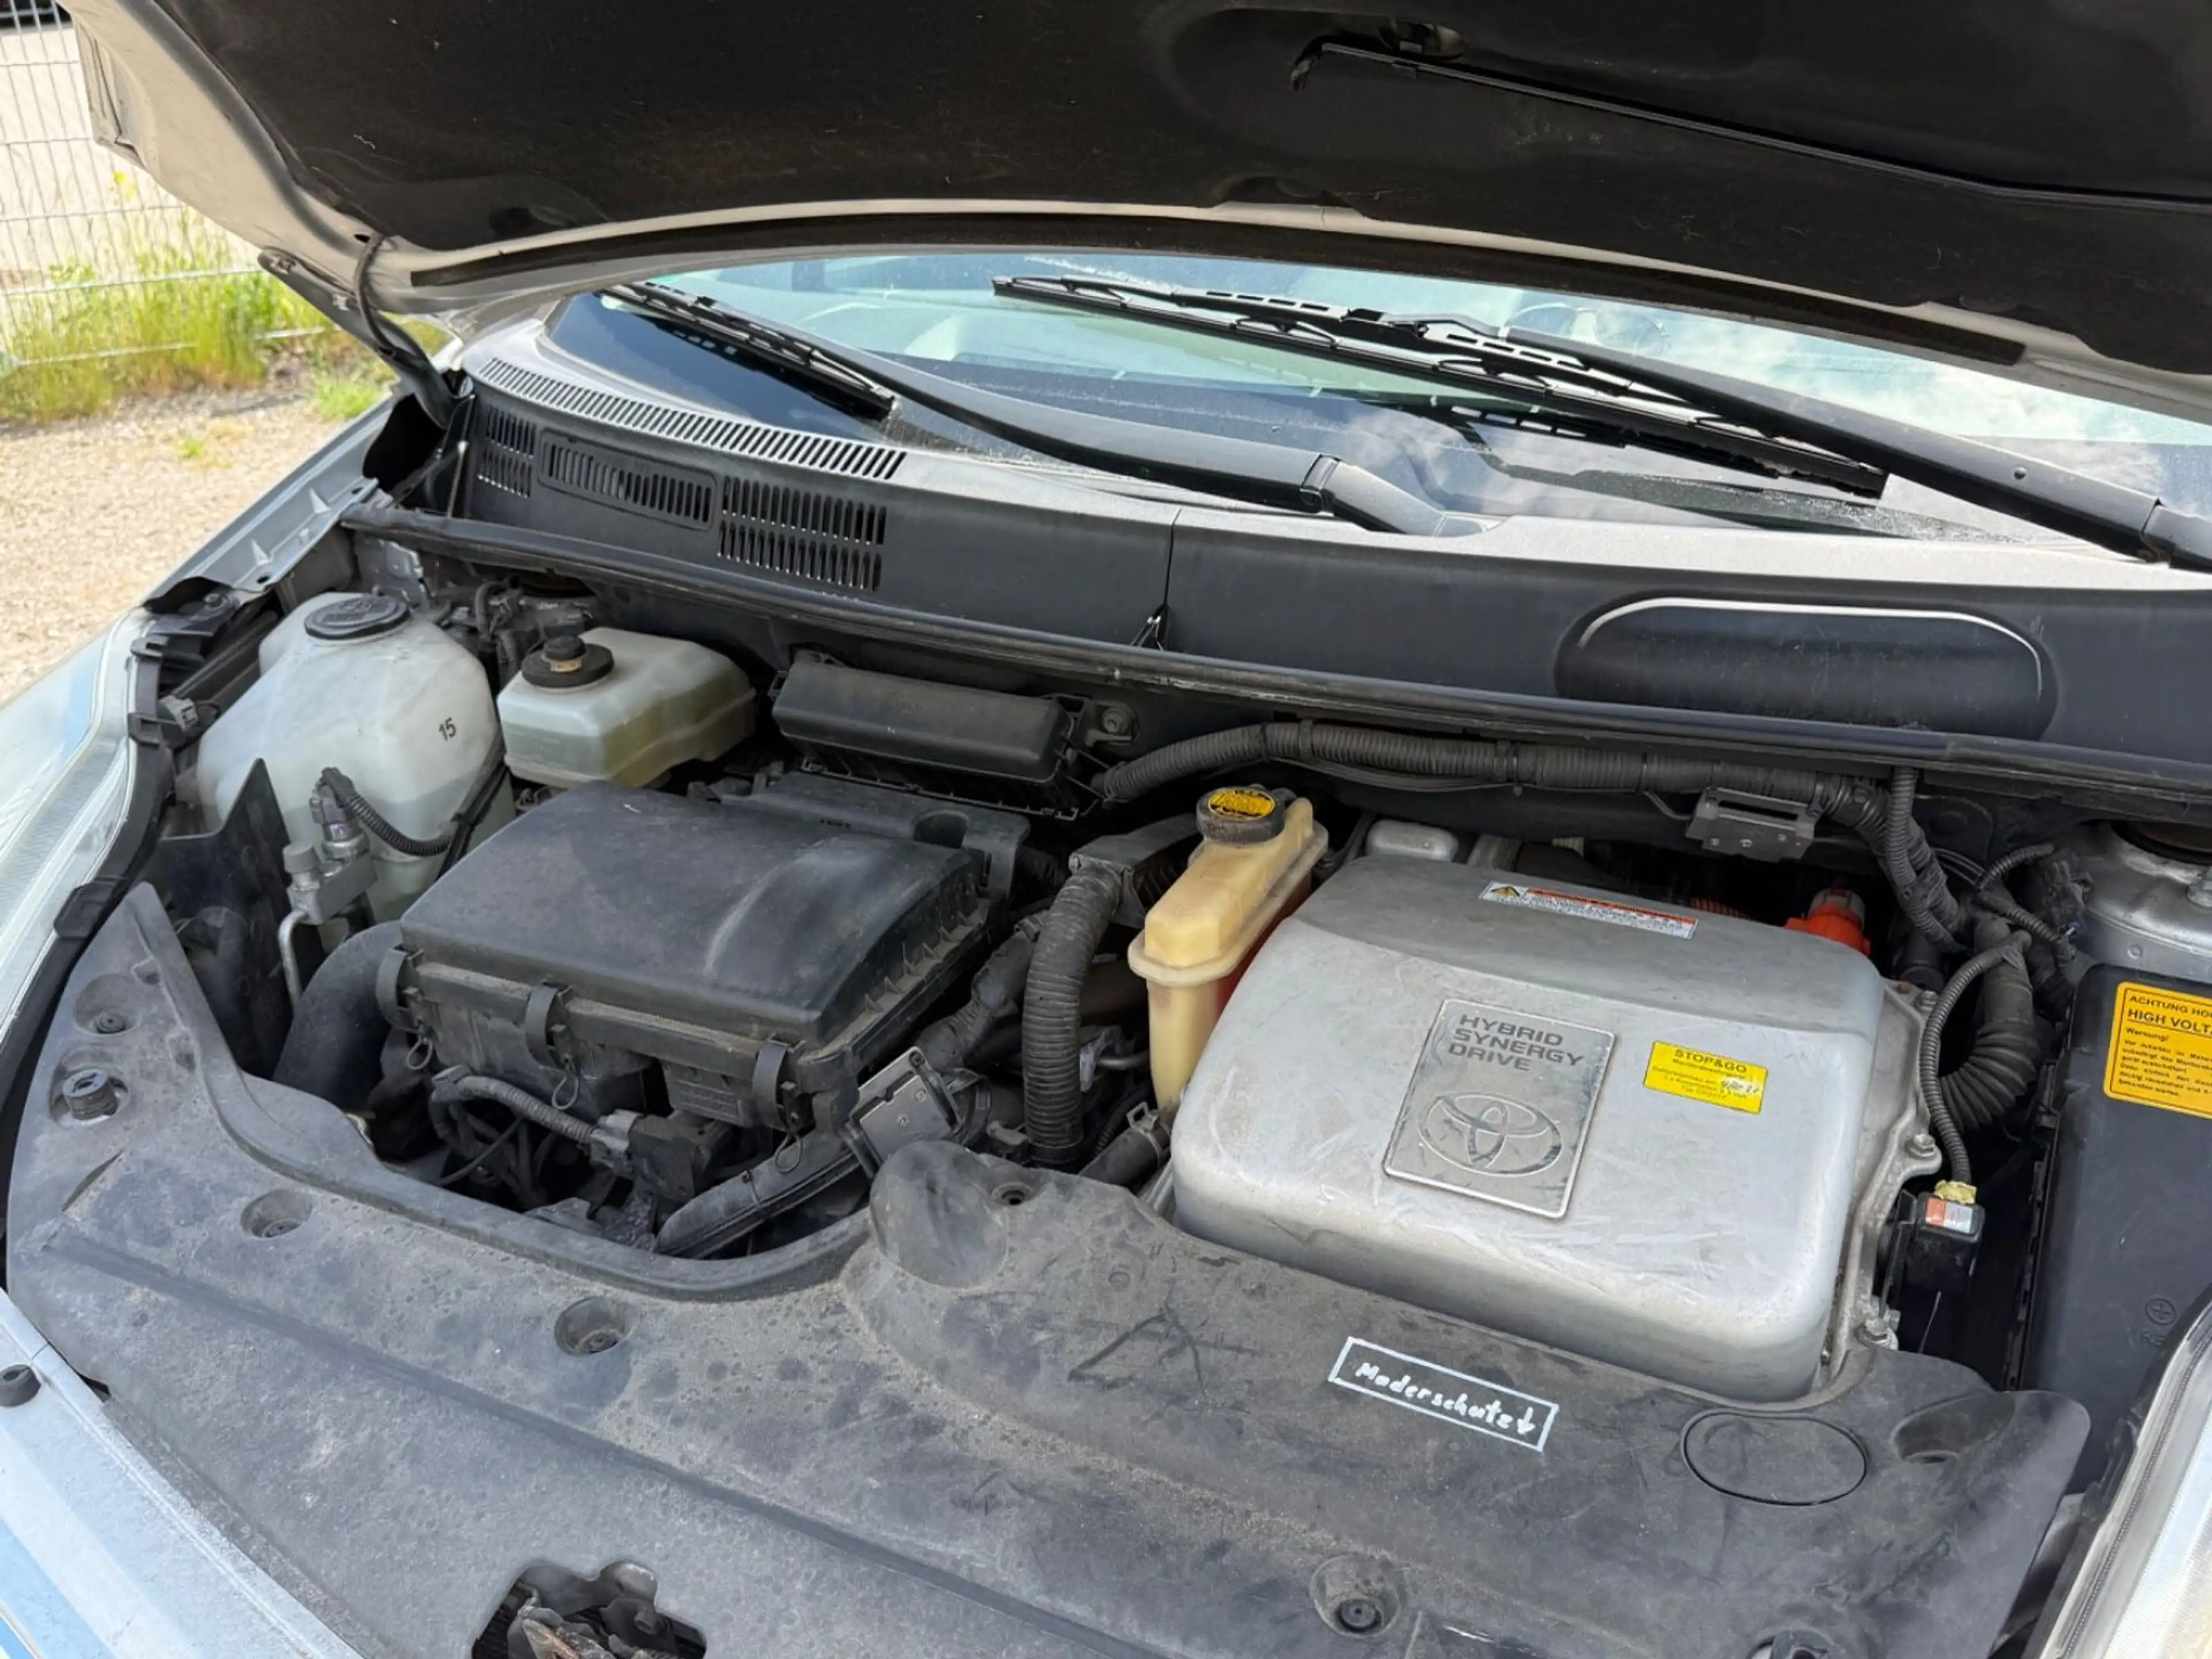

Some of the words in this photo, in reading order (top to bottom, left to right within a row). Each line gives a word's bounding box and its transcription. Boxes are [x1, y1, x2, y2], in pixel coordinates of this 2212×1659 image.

[438, 717, 457, 741] 15
[2129, 994, 2188, 1014] ACHTUNG
[2191, 1007, 2212, 1018] HO
[1460, 1014, 1563, 1046] HYBRID
[2127, 1009, 2166, 1025] HIGH
[2171, 1016, 2212, 1035] VOLT
[1448, 1043, 1532, 1071] DRIVE
[1453, 1028, 1585, 1067] SYNERGY
[1673, 1048, 1747, 1073] STOP&GO
